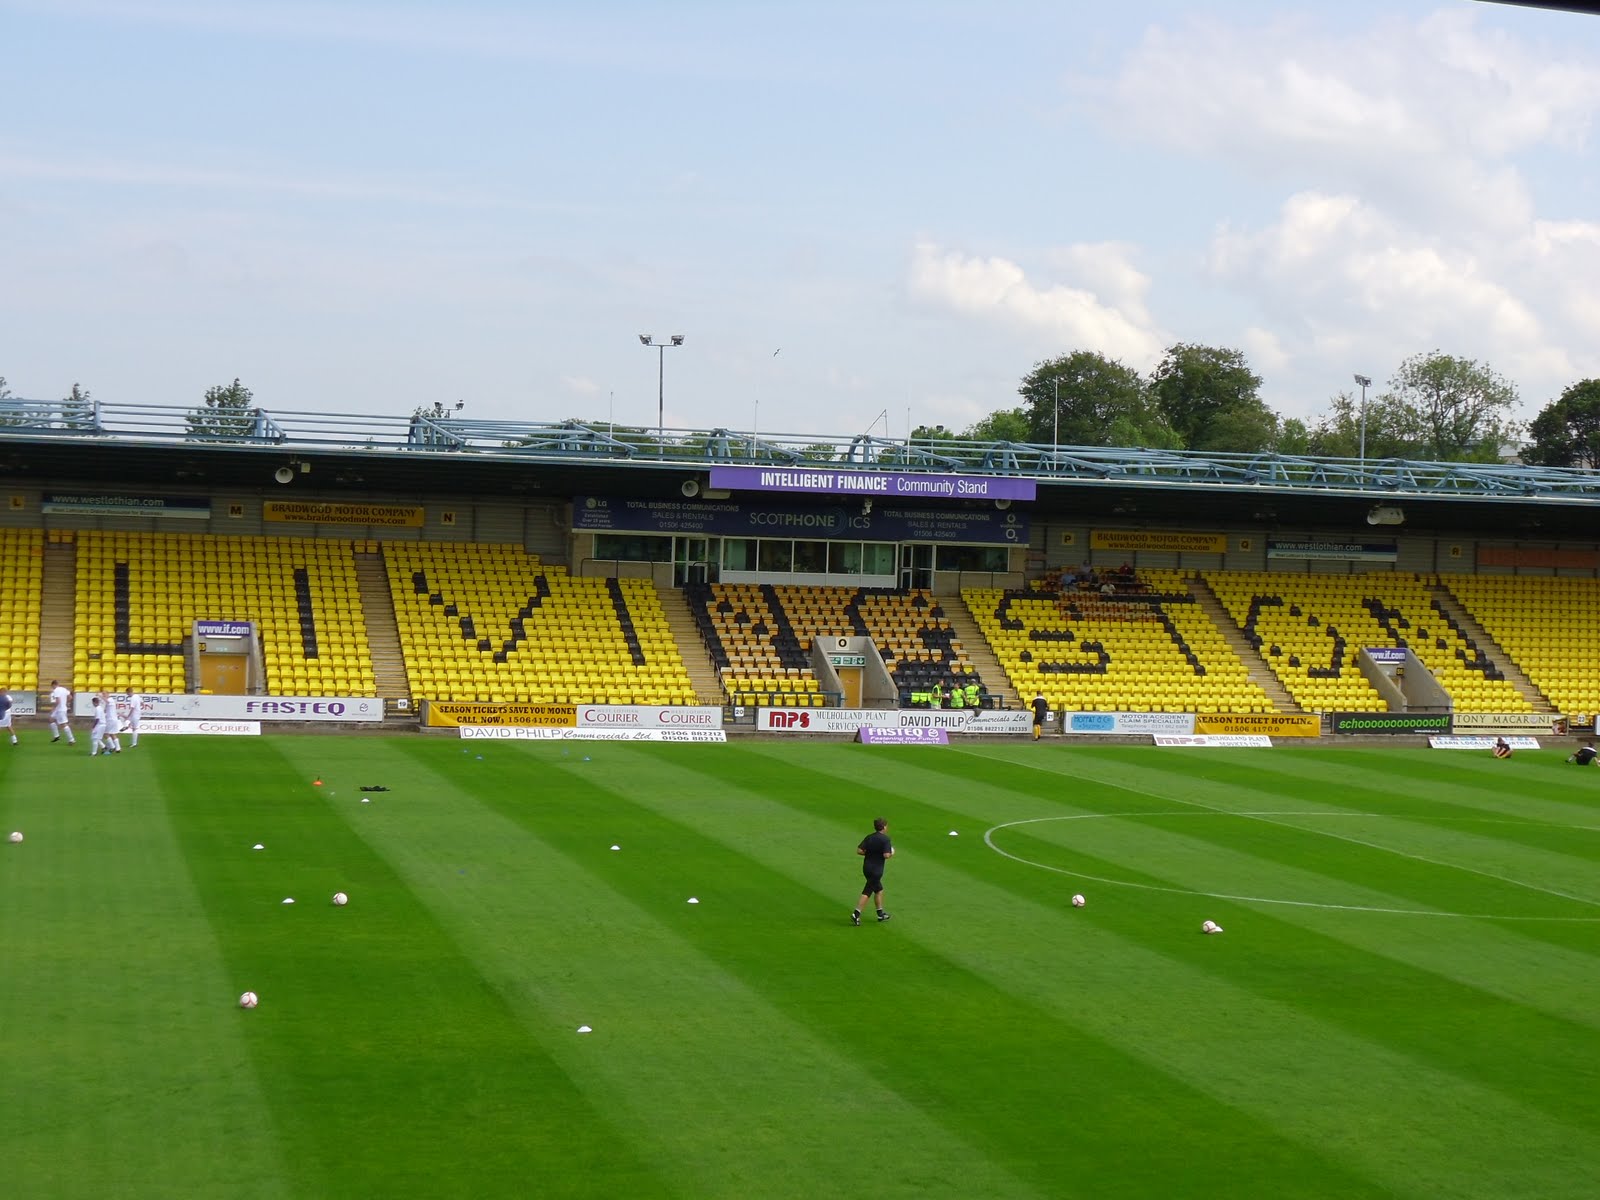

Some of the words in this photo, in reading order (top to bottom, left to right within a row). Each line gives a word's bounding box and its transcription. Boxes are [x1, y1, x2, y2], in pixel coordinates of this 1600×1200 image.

[761, 472, 833, 489] INTELLIGENT
[897, 477, 954, 496] Community
[957, 479, 987, 494] Stand
[52, 494, 164, 506] www.westlothian.com
[230, 506, 241, 515] M
[271, 503, 332, 514] BRAIDWOOD
[335, 505, 369, 515] MOTOR
[371, 507, 416, 517] COMPANY
[627, 501, 647, 509] TOTAL
[648, 502, 681, 510] BUSINESS
[682, 503, 740, 512] COMMUNICATIONS
[284, 513, 406, 525] www.braidwoodmotors.com
[443, 512, 452, 521] N
[682, 512, 714, 520] RENTALS
[750, 512, 835, 527] SCOTPHONE
[848, 517, 871, 529] ICS
[904, 511, 935, 519] BUSINESS
[935, 512, 990, 521] COMMUNICATIONS
[907, 520, 929, 528] SALES
[937, 521, 967, 529] RENTALS
[1063, 535, 1072, 543] P
[1097, 533, 1147, 542] BRAIDWOOD
[1150, 534, 1180, 543] MOTOR
[1182, 536, 1218, 545] COMPANY
[1108, 541, 1210, 551] www.braidwoodmotors.com
[1240, 541, 1249, 549] Q
[1275, 541, 1362, 551] www.westlothian.com
[198, 624, 249, 634] www.if.com
[109, 695, 174, 704] FOOBALL
[246, 701, 346, 717] FASTEQ
[439, 706, 473, 714] SEASON
[473, 706, 508, 714] TICKETS
[547, 707, 577, 715] MONEY
[456, 716, 478, 724] CALL
[584, 709, 639, 723] COURIER
[659, 711, 712, 724] COURIER
[769, 711, 810, 728] MPS
[816, 711, 863, 720] MULHOLLAND
[865, 711, 888, 720] PLANT
[966, 714, 1010, 725] Commercials
[1235, 716, 1270, 724] TICKET
[1455, 714, 1486, 723] TONY
[827, 722, 859, 731] SERVICES
[901, 716, 931, 727] DAVID
[934, 716, 964, 727] PHILP
[198, 722, 250, 733] COURIER
[462, 727, 511, 738] DAVID
[515, 728, 561, 738] PHILP
[868, 727, 923, 737] FASTEQ
[563, 730, 629, 740] Commercials
[1155, 737, 1207, 745] MPS
